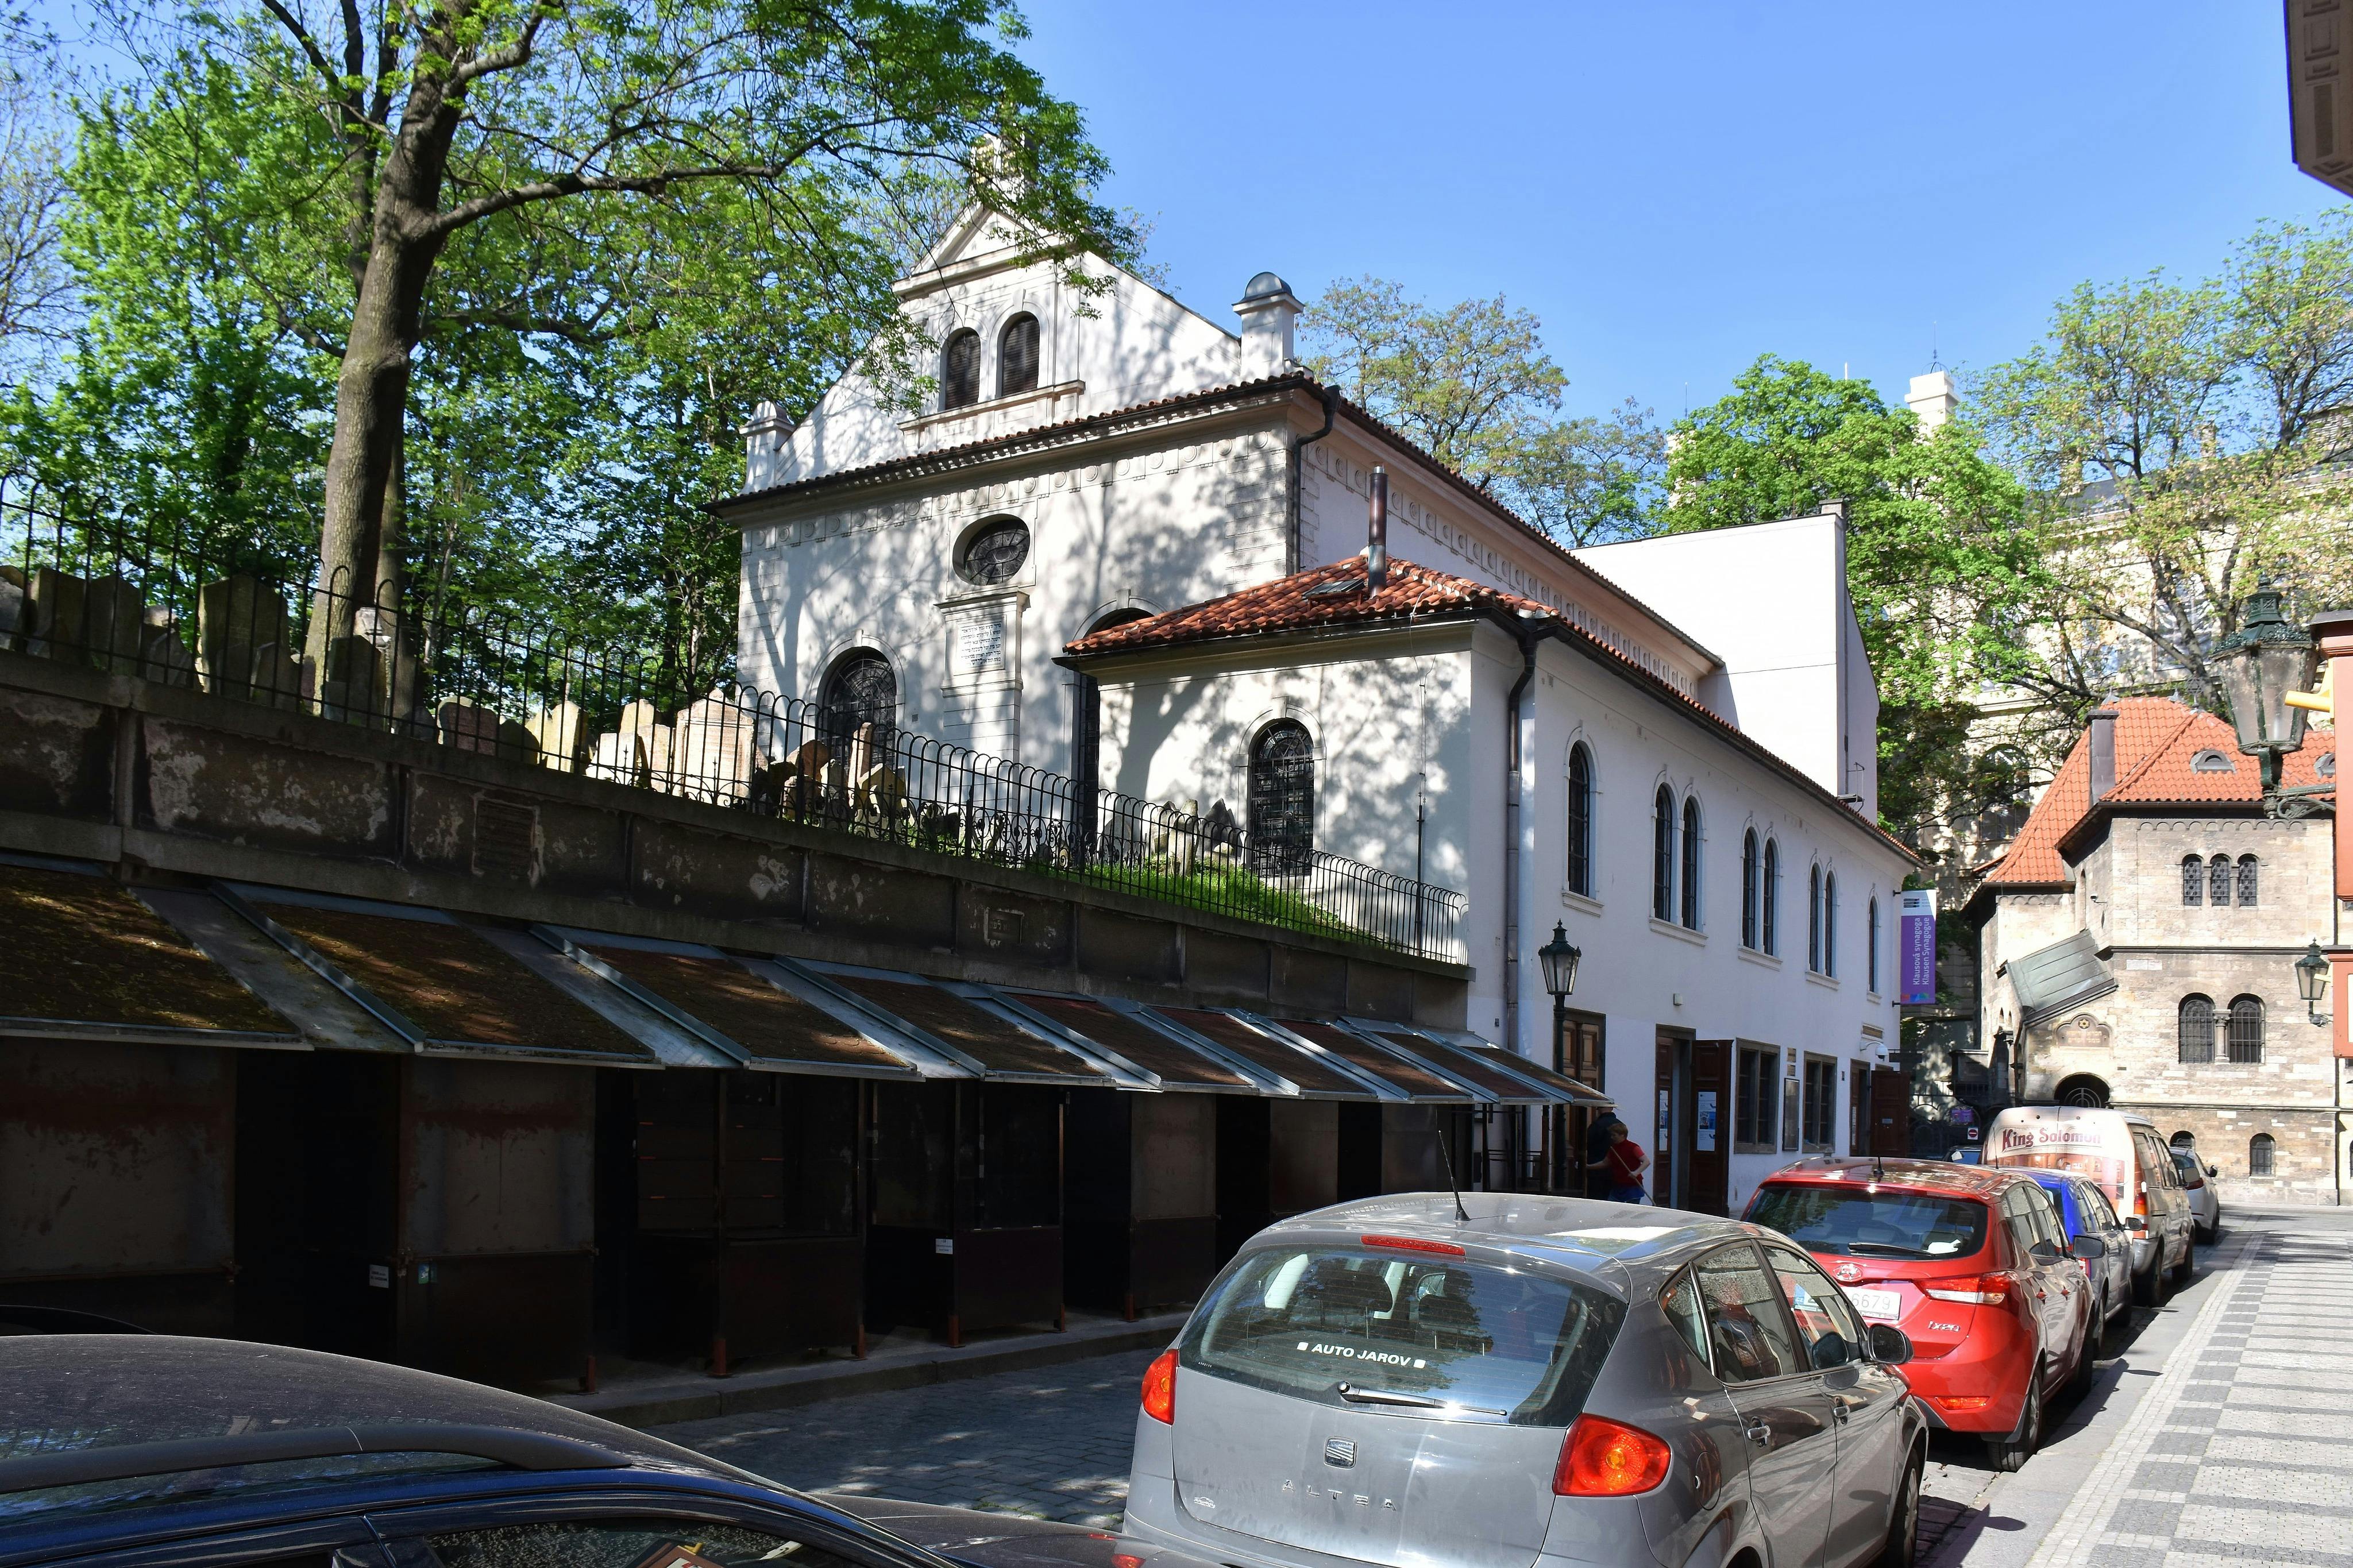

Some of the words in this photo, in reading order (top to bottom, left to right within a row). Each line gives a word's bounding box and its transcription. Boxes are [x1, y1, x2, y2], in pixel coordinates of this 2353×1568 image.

[1922, 917, 1931, 956] Synagogue
[1912, 953, 1920, 985] Klausová
[2002, 1129, 2034, 1151] King
[2039, 1127, 2101, 1144] Solomon
[1851, 1293, 1891, 1310] 6679
[1311, 1343, 1355, 1357] AUTO
[1356, 1350, 1411, 1366] JAROV
[1282, 1478, 1397, 1512] ALTEA
